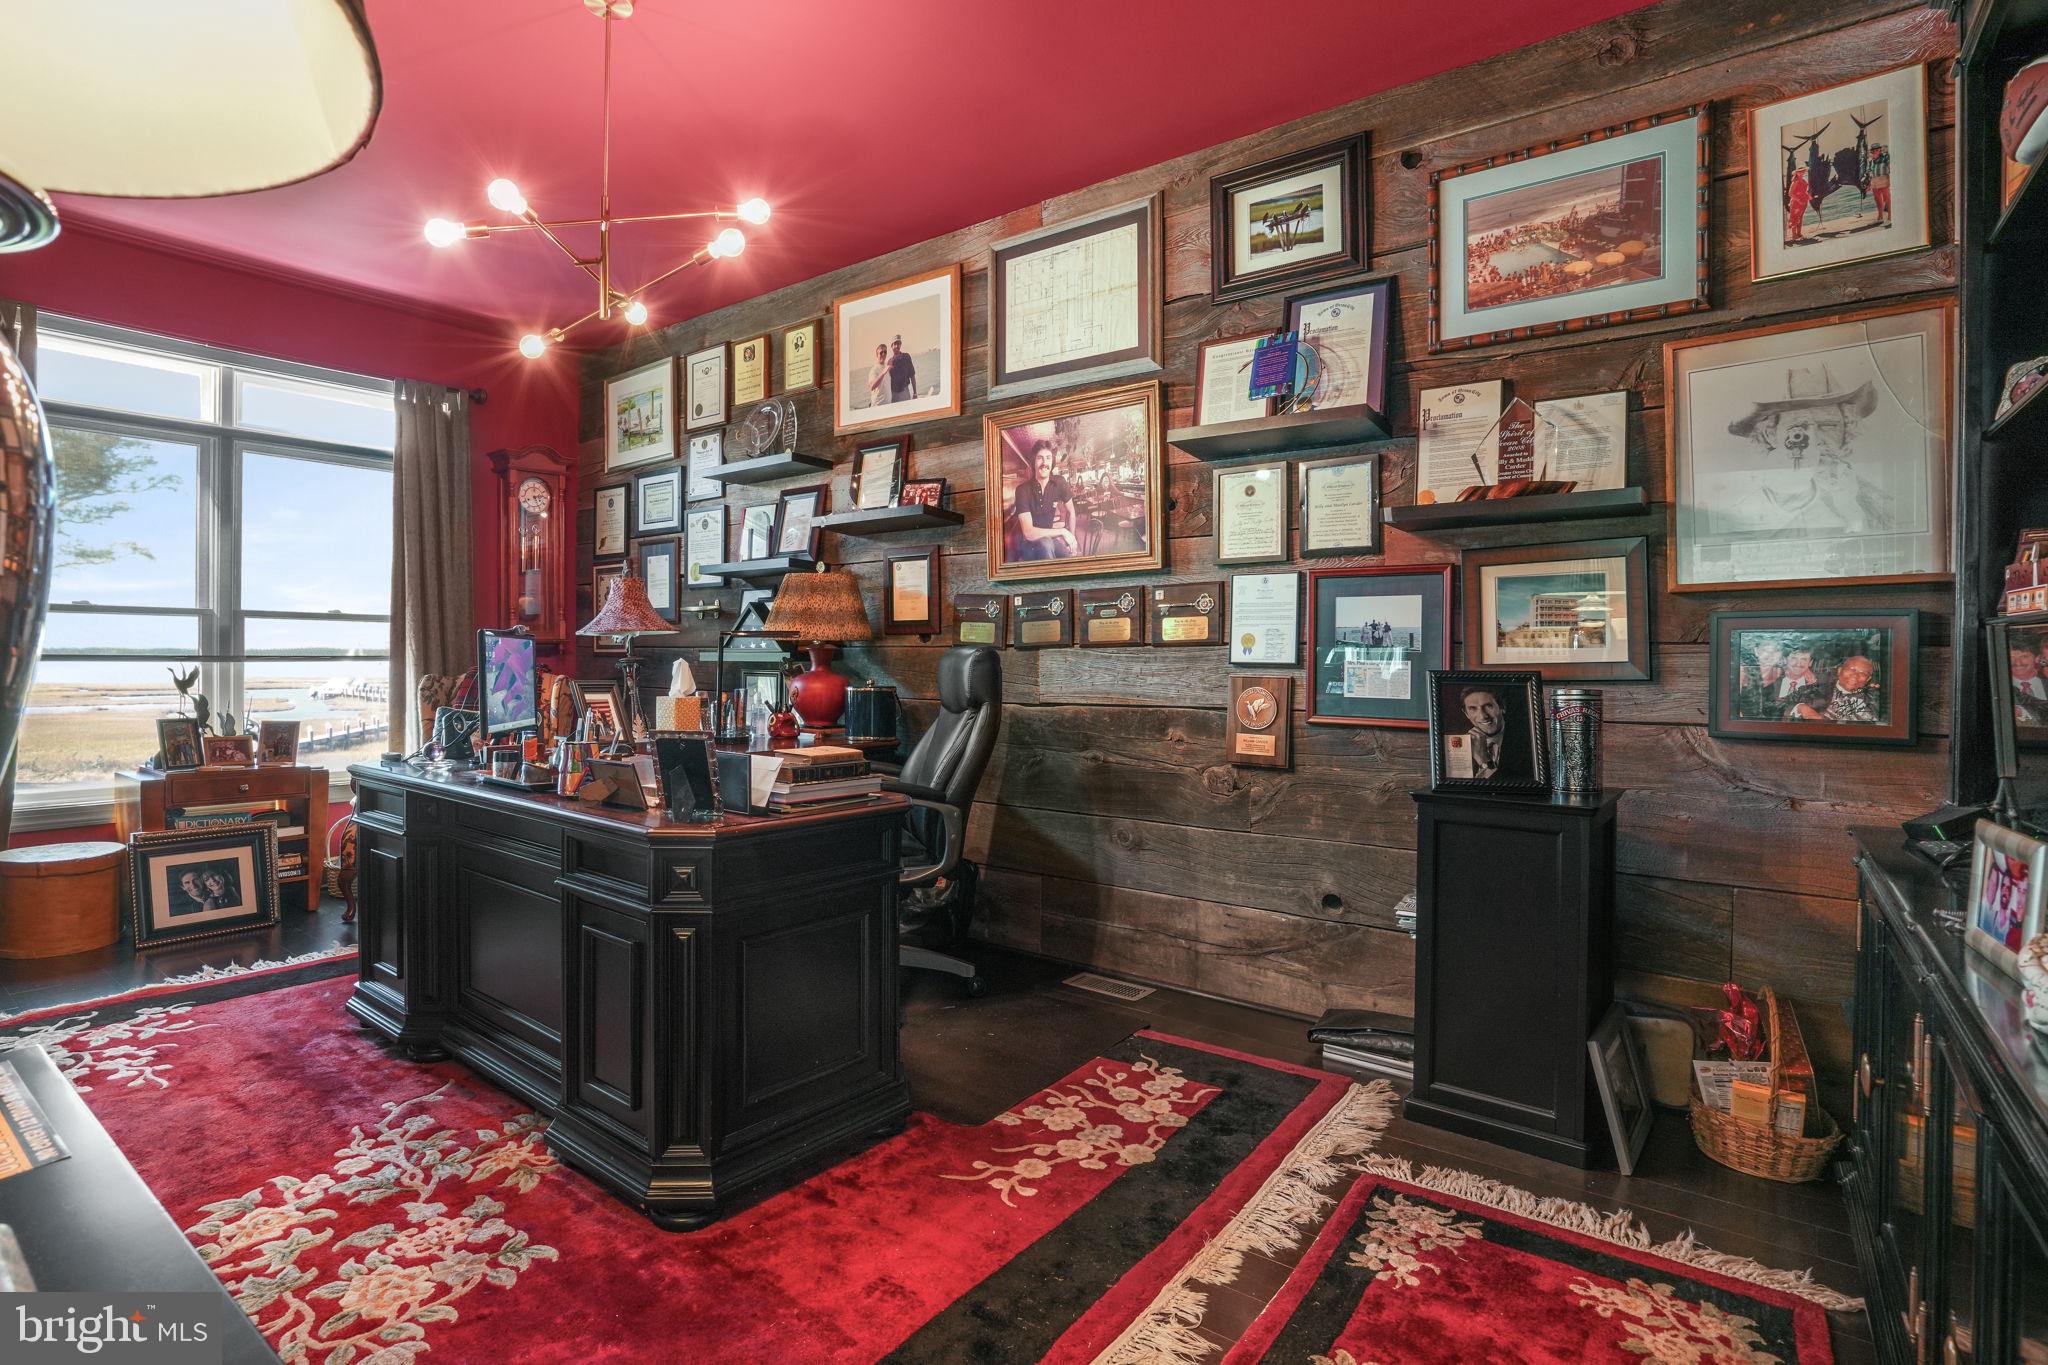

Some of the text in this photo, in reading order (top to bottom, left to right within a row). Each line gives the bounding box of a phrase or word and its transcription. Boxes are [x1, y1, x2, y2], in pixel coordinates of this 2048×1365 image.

[1303, 322, 1339, 342] Proclamation
[1422, 408, 1463, 431] Proclamation
[1508, 421, 1524, 430] The
[1499, 426, 1536, 440] Spirit of
[1556, 706, 1580, 719] CHIVAS
[184, 816, 247, 831] DICTIONARY
